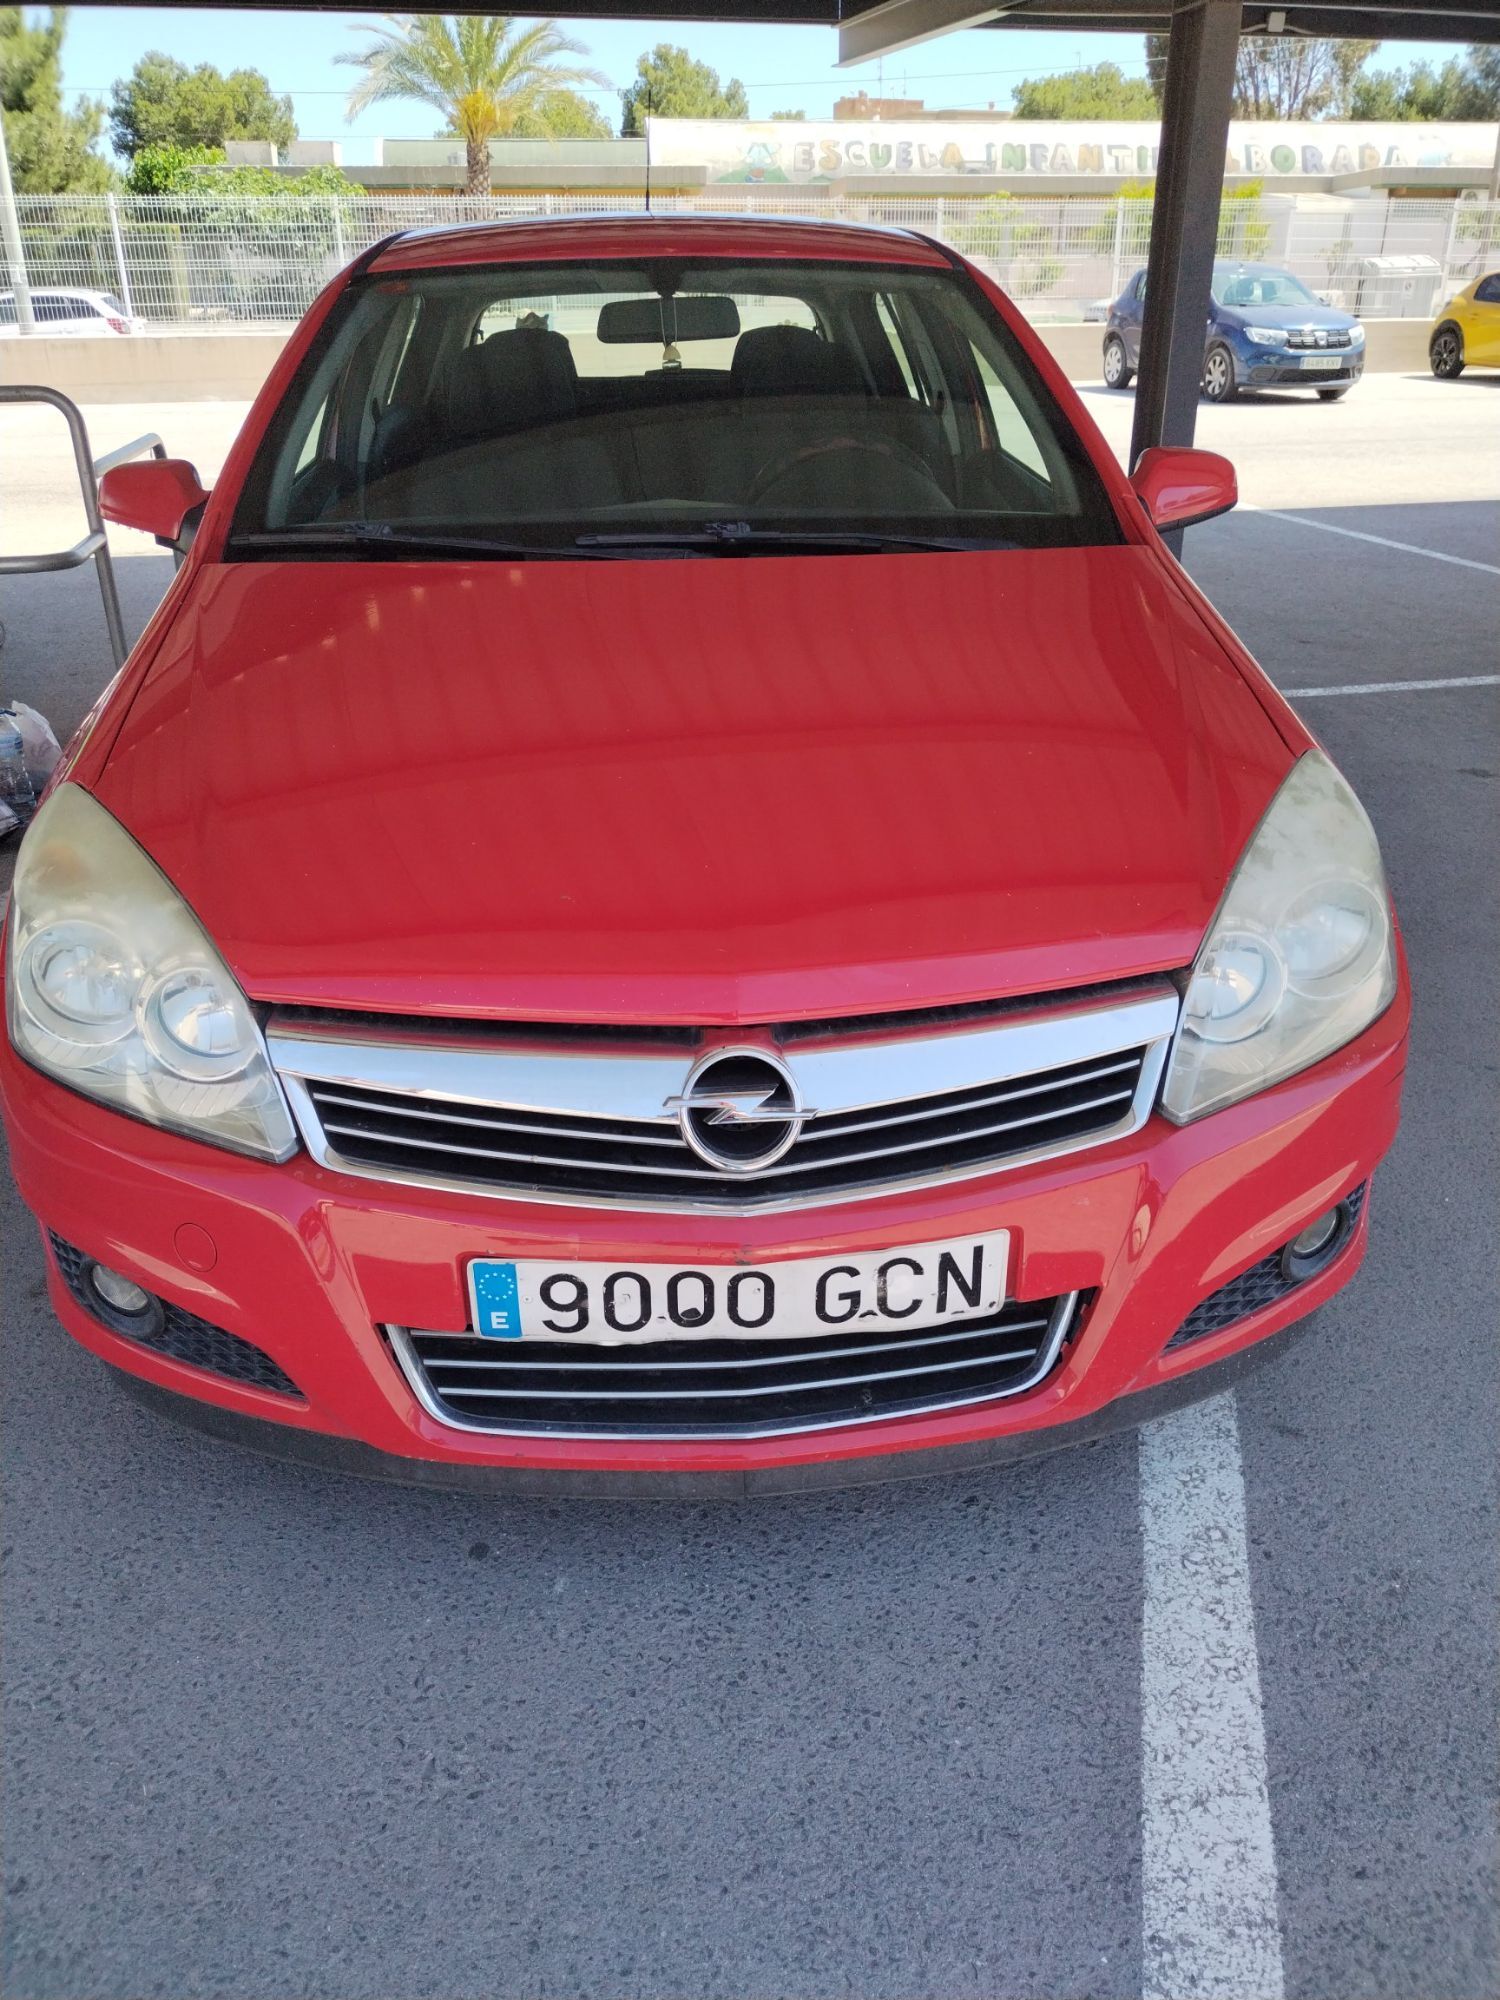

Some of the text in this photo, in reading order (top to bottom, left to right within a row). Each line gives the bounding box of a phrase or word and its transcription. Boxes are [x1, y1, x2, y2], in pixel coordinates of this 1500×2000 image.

[793, 139, 965, 172] ESCUELA
[538, 1244, 986, 1333] 9000 GCN
[490, 1311, 510, 1329] E
